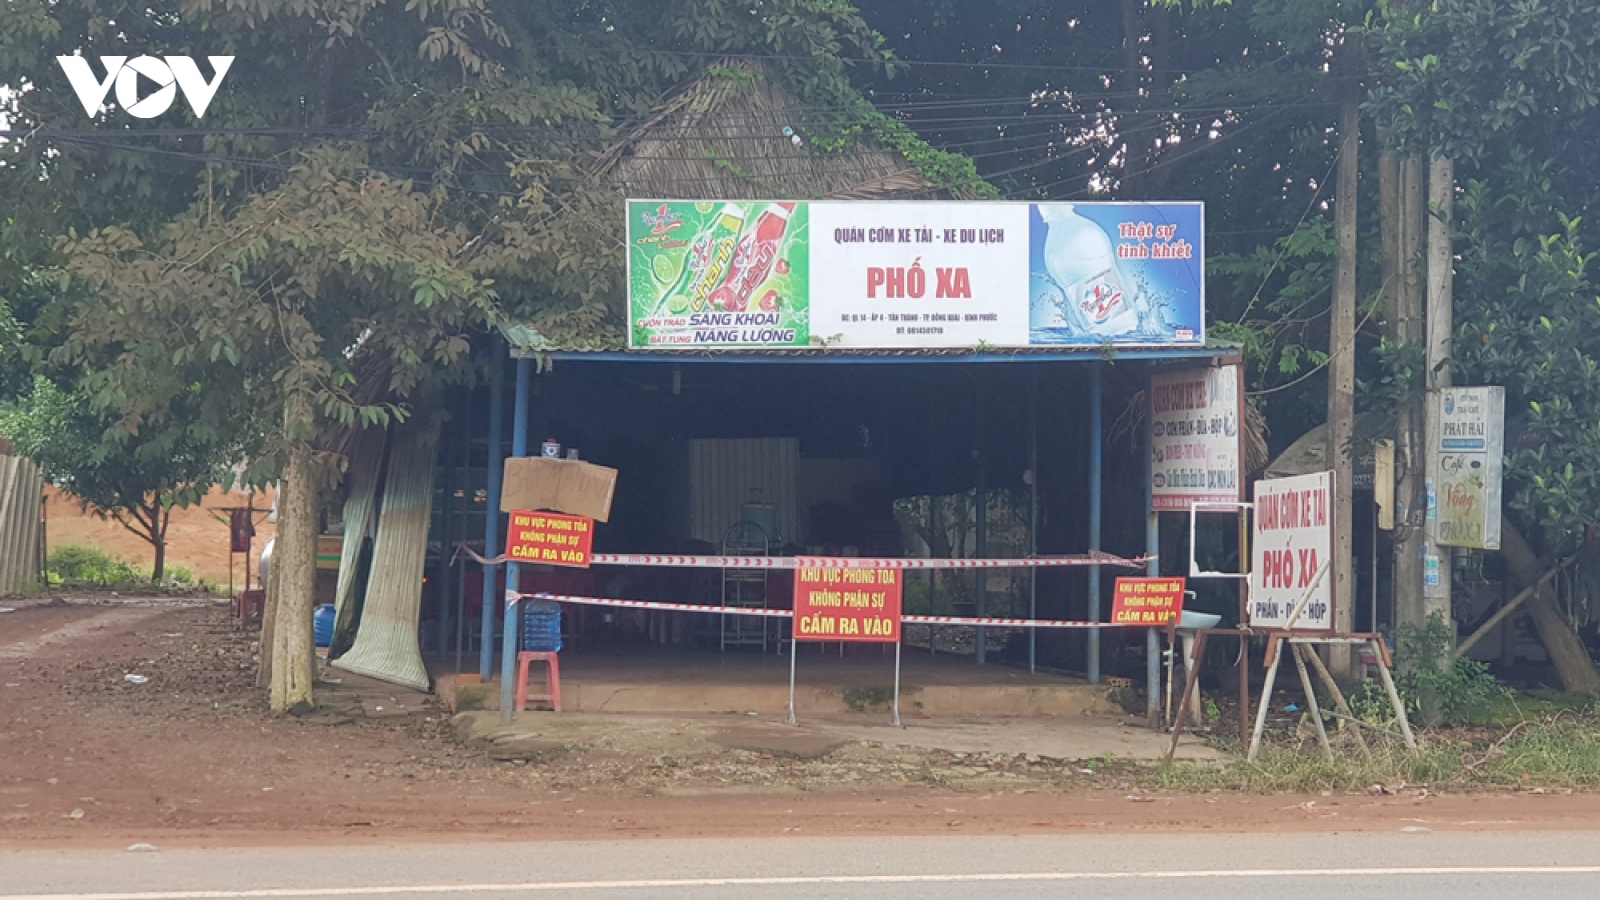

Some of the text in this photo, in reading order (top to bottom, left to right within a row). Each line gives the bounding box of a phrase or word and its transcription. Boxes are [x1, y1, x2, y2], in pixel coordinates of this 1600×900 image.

[834, 226, 865, 244] QUÁN
[869, 226, 894, 242] CƠM
[898, 228, 911, 242] XE
[914, 225, 932, 242] TẢI
[944, 228, 956, 242] XE
[960, 228, 976, 242] DU
[979, 228, 1004, 246] LỊCH
[1152, 240, 1191, 258] khiết
[867, 256, 972, 298] PHỐ XA
[1258, 476, 1326, 535] QUÁN CƠM XE TẢI
[515, 515, 529, 527] KHU
[547, 518, 571, 531] PHONG
[520, 530, 545, 542] KHÔNG
[512, 543, 584, 563] CẤM RA VÀO
[1262, 535, 1320, 589] PHỐ XA
[801, 568, 820, 582] KHU
[843, 568, 875, 584] PHONG
[809, 588, 886, 612] KHÔNG PHẬN SỰ
[1117, 608, 1140, 622] CẤM
[1142, 611, 1155, 622] RA
[1308, 599, 1326, 623] HỘP
[800, 610, 892, 635] CẤM RA VÀO
